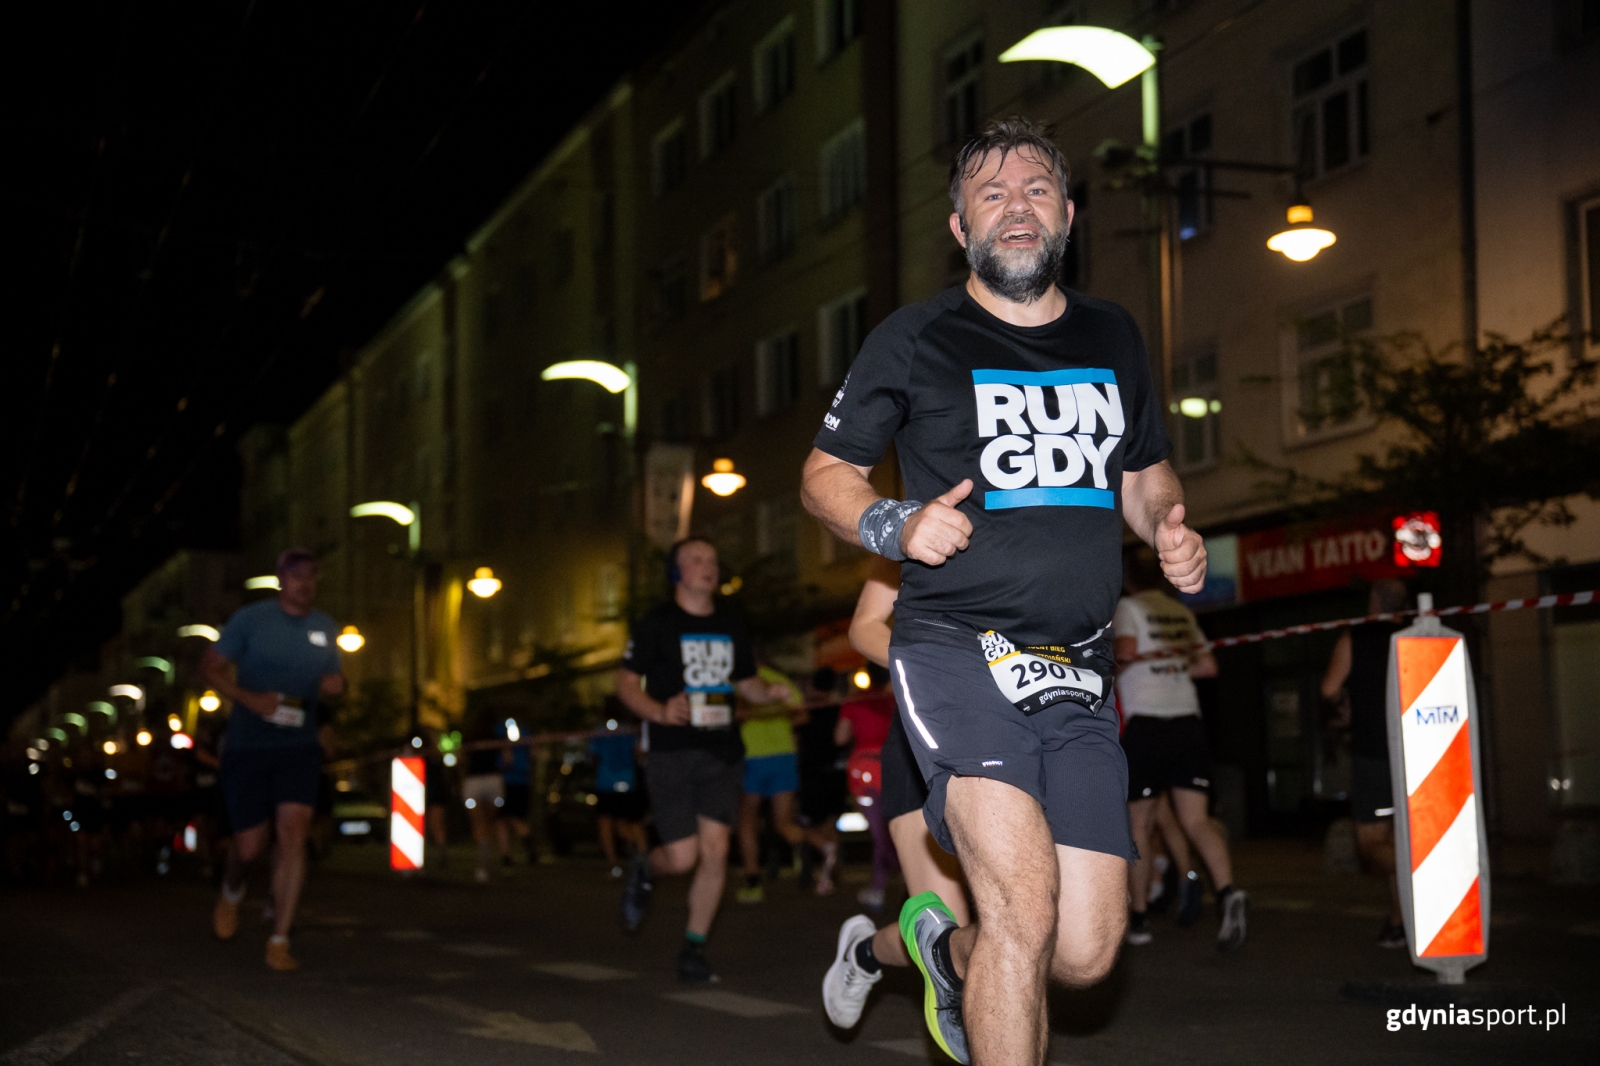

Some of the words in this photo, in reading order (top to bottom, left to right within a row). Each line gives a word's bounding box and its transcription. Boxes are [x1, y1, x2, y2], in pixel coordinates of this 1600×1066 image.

[974, 383, 1126, 438] RUN
[980, 434, 1122, 490] GDY
[1310, 529, 1388, 569] TATTO
[680, 640, 734, 665] RUN
[984, 641, 1016, 662] GDY
[683, 660, 733, 687] GDY
[1010, 660, 1082, 690] 2901
[1039, 688, 1092, 705] gdyniasport.pl
[1416, 705, 1459, 725] MTM
